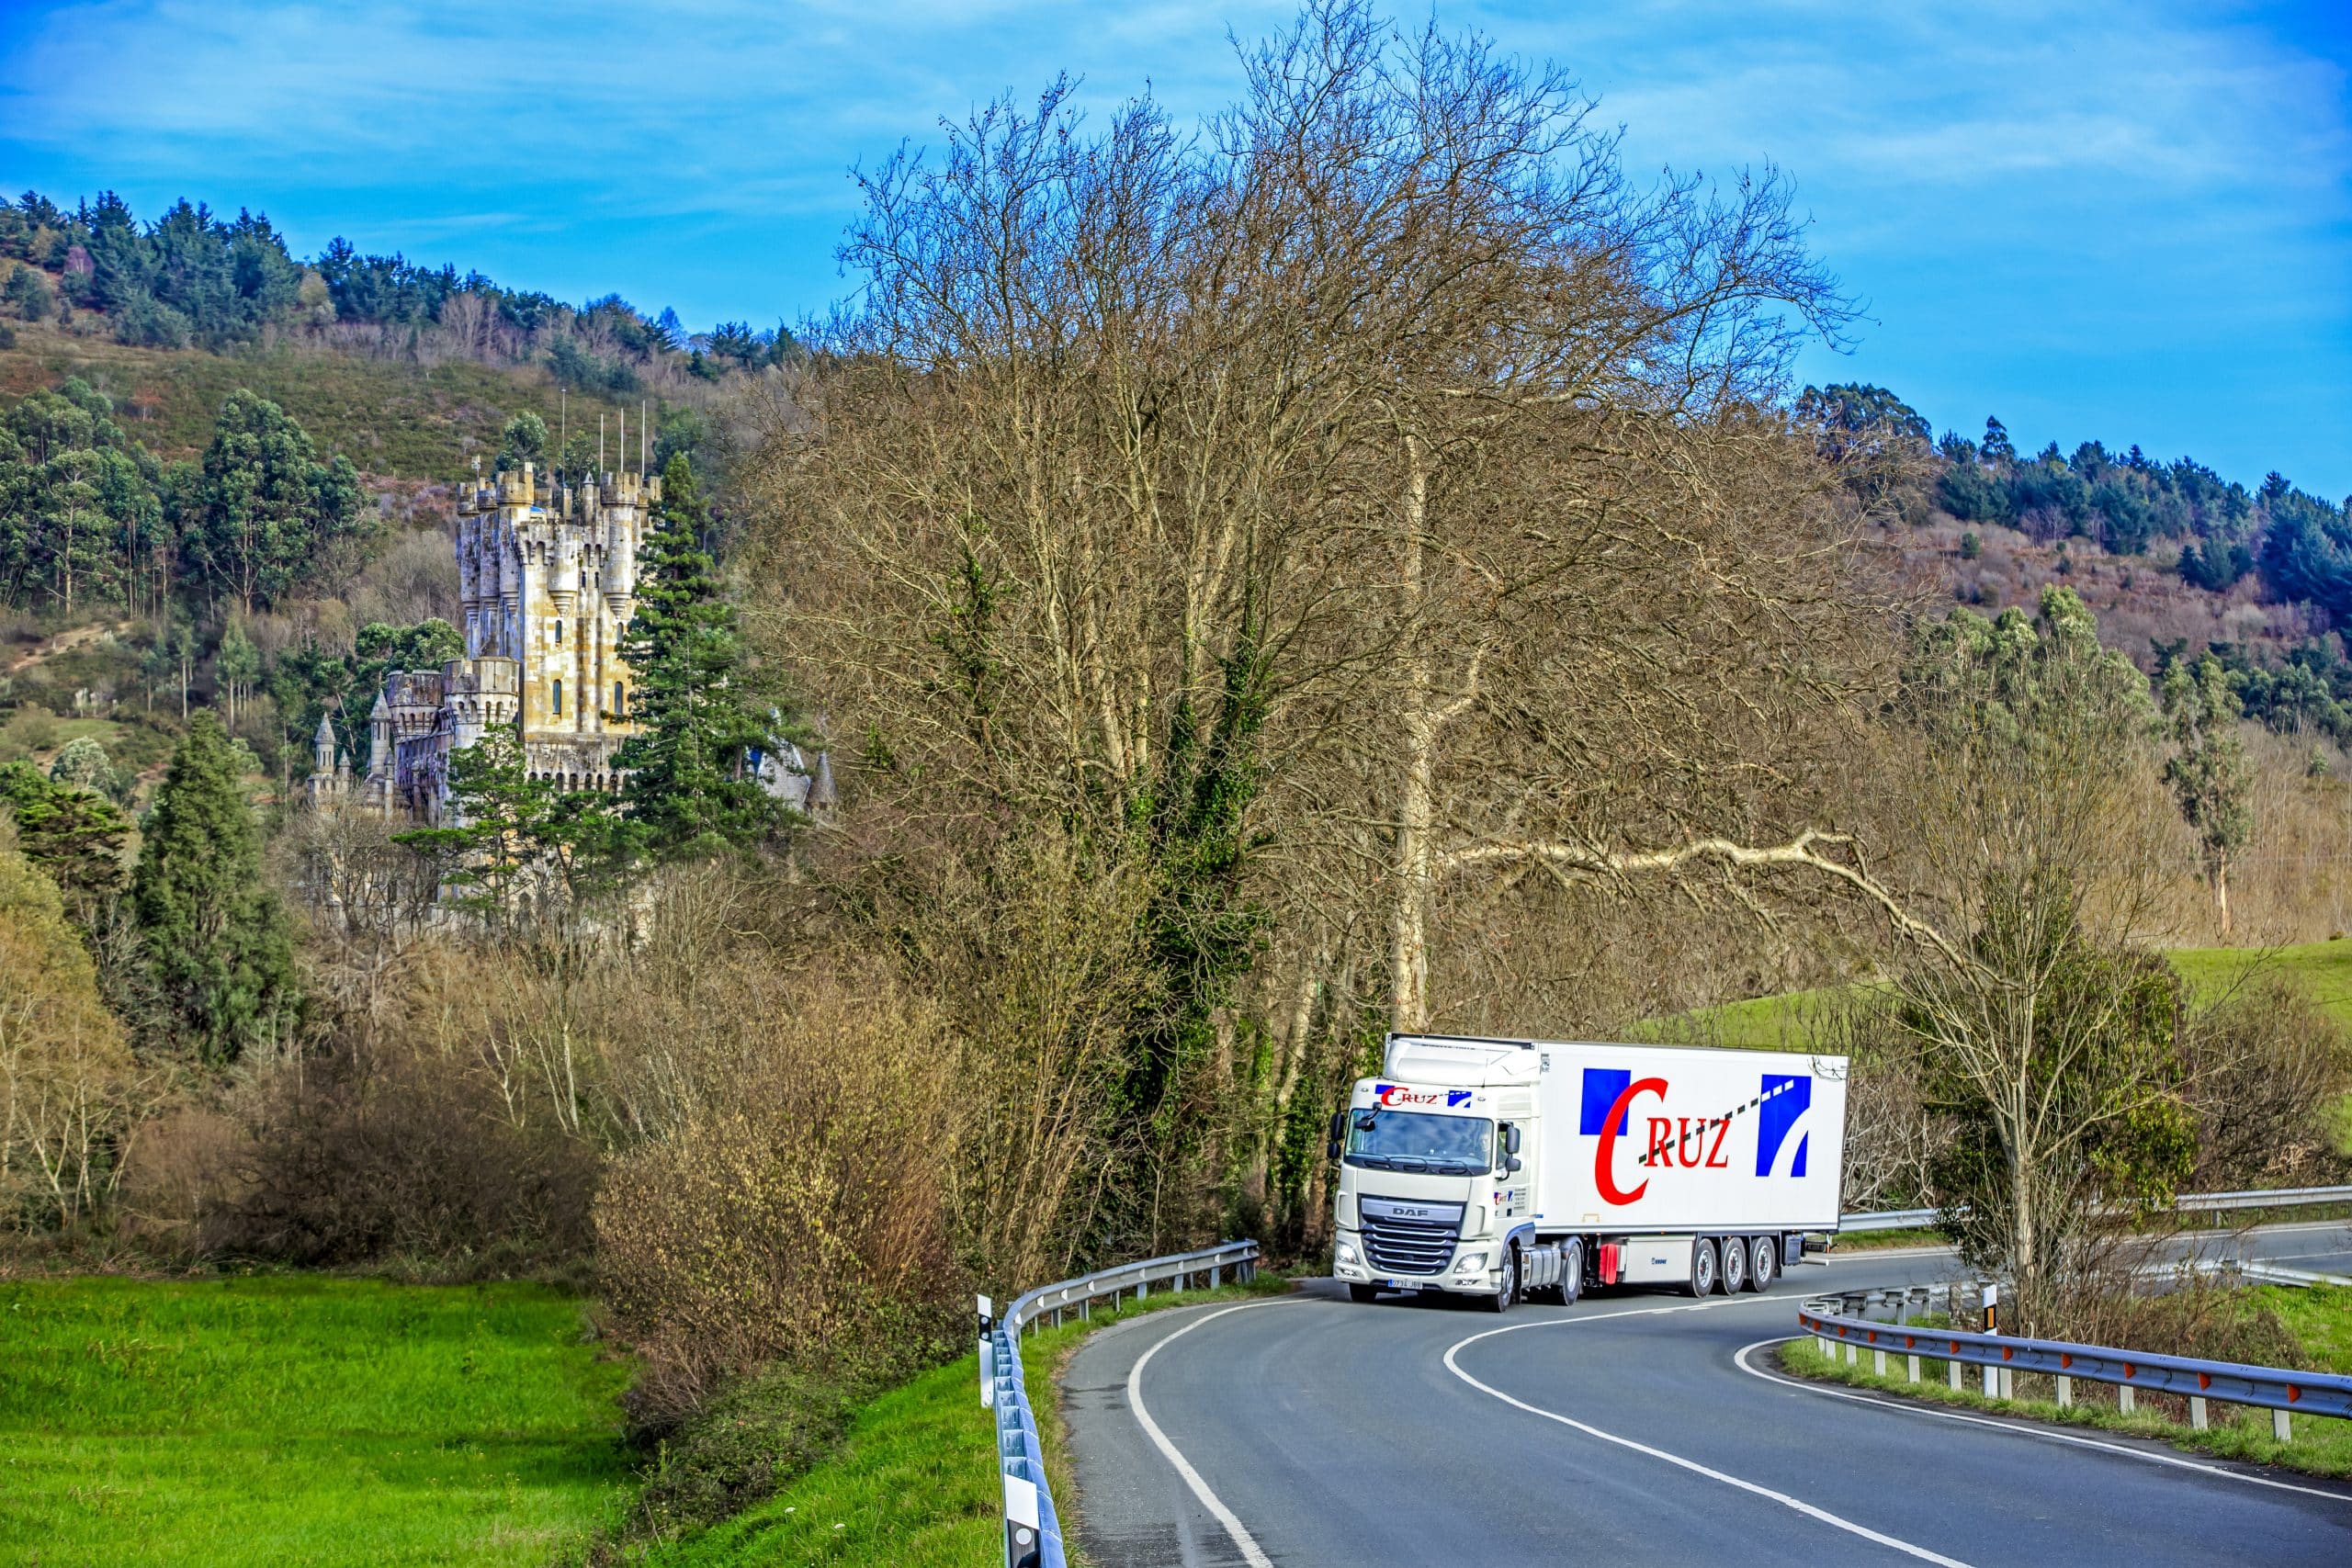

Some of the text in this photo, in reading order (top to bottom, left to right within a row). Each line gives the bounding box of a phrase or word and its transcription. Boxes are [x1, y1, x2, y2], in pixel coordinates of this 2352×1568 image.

[1381, 1087, 1438, 1107] CRUZ
[1595, 1077, 1731, 1206] CRUZ
[1392, 1207, 1429, 1217] DAF
